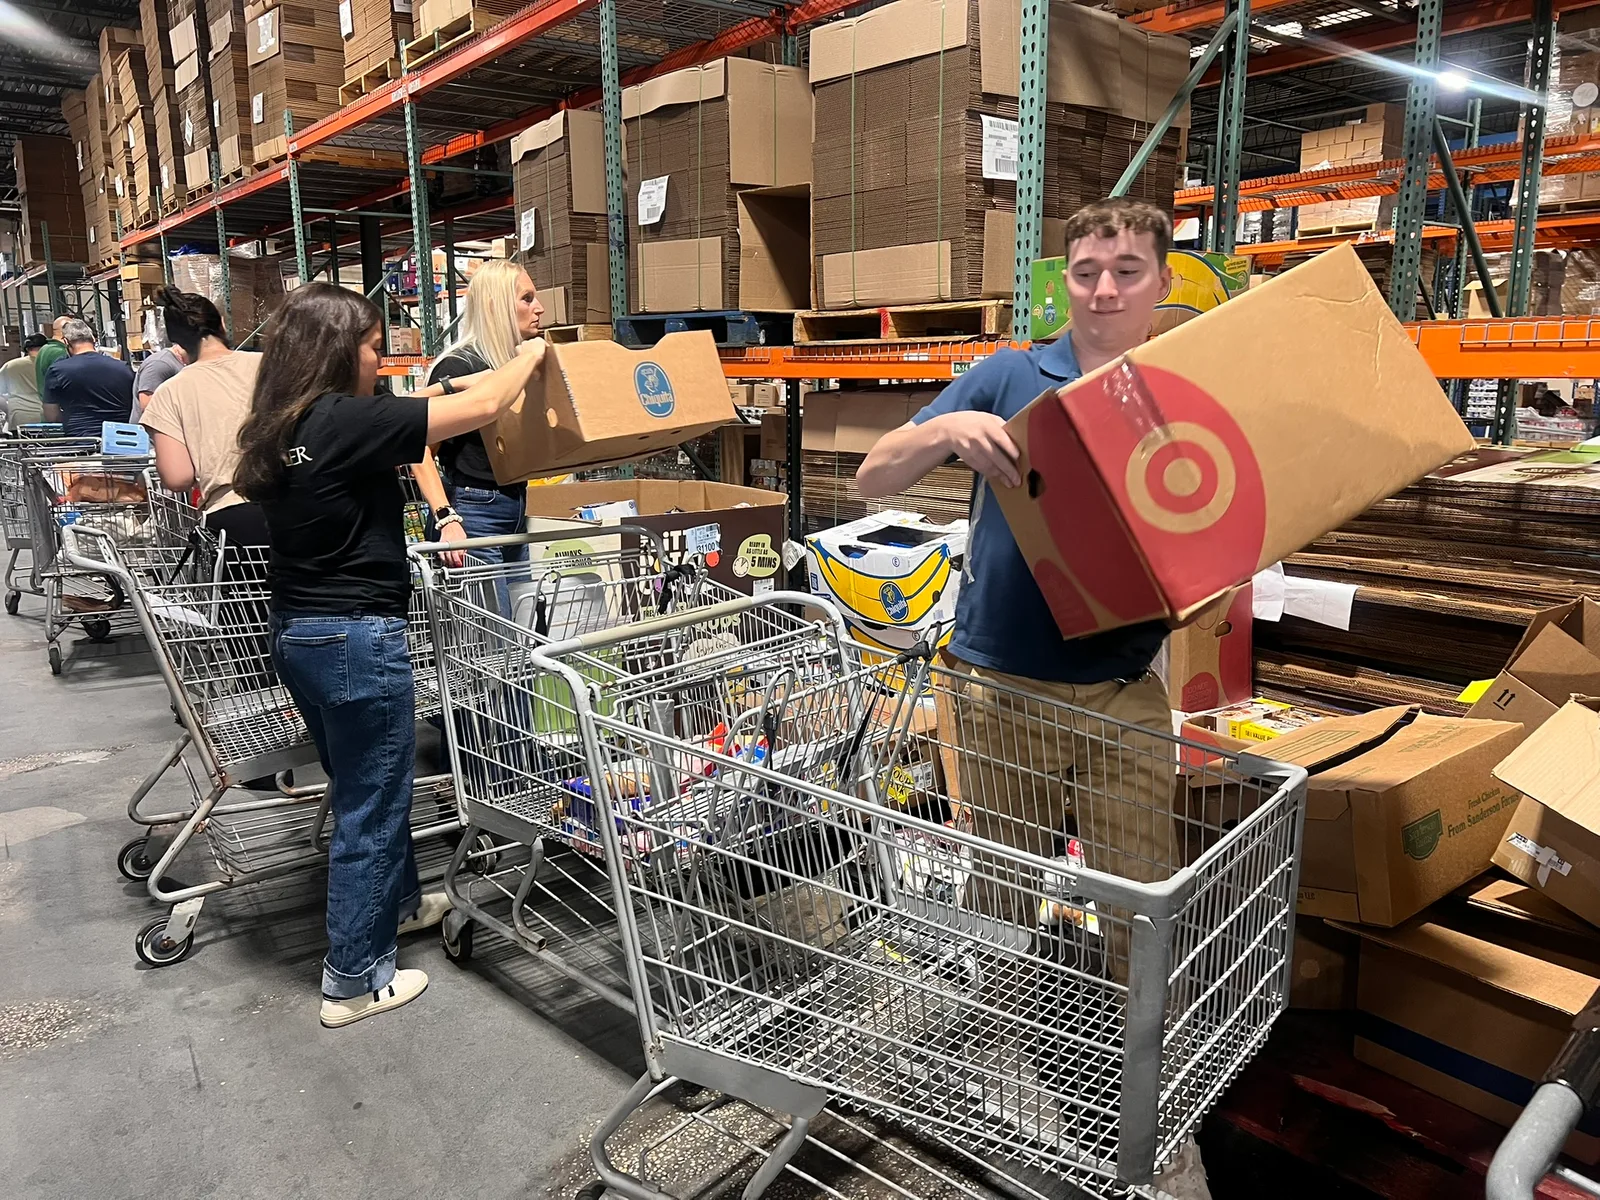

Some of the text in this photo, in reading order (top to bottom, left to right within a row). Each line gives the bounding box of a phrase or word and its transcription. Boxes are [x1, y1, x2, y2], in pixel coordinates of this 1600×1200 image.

[750, 555, 777, 568] 5 MINS
[1447, 824, 1467, 838] From
[1467, 802, 1500, 828] Sanderson
